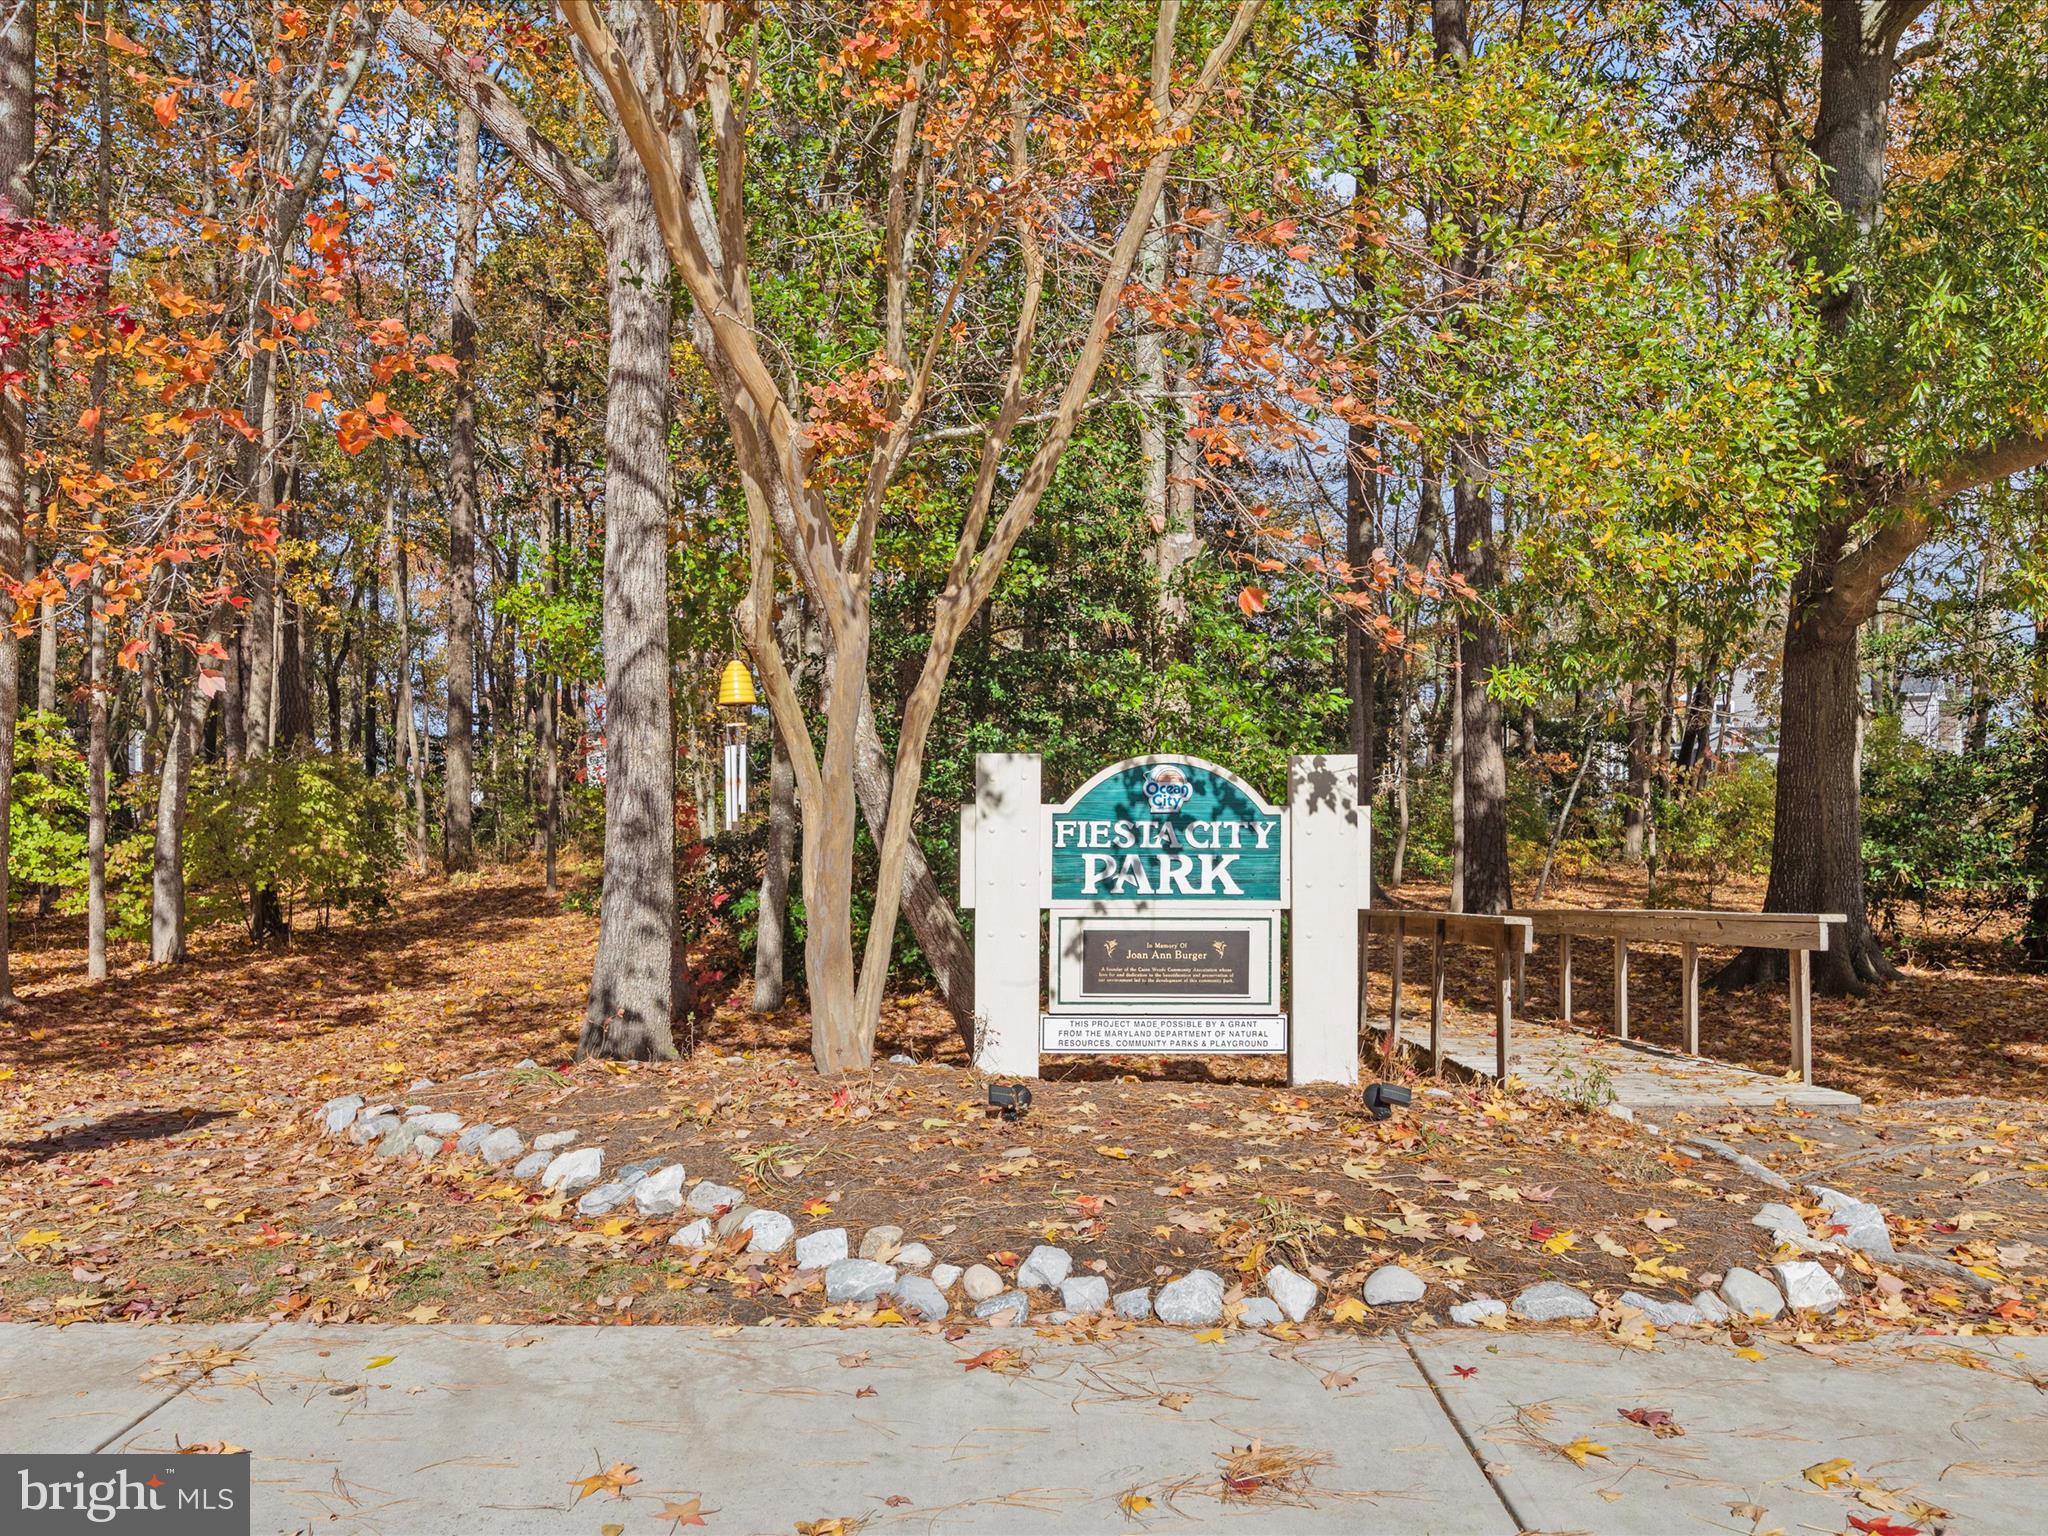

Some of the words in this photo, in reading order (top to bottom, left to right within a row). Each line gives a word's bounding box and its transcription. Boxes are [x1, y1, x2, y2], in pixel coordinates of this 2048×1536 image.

[1146, 782, 1189, 798] Ocean
[1152, 794, 1182, 810] City
[1055, 820, 1181, 848] FIESTA
[1184, 820, 1276, 849] CITY
[1081, 853, 1244, 895] PARK
[1126, 950, 1148, 960] Joan
[1152, 950, 1172, 960] Ann
[1174, 950, 1207, 962] Burger
[1070, 1020, 1089, 1028] THIS
[1092, 1020, 1130, 1028] PROJECT
[1134, 1020, 1158, 1028] MADE
[1161, 1020, 1202, 1028] POSSIBLE
[1206, 1020, 1217, 1028] BY
[1220, 1020, 1226, 1028] A
[1228, 1020, 1257, 1028] GRANT
[1058, 1030, 1082, 1038] FROM
[1086, 1030, 1102, 1038] THE
[1104, 1030, 1152, 1038] MARYLAND
[1154, 1030, 1212, 1038] DEPARTMENT
[1215, 1030, 1226, 1038] OF
[1229, 1030, 1268, 1038] NATURAL
[1116, 1040, 1167, 1048] COMMUNITY
[1170, 1040, 1199, 1048] PARKS
[1202, 1040, 1207, 1048] &
[1210, 1040, 1268, 1048] PLAYGROUND
